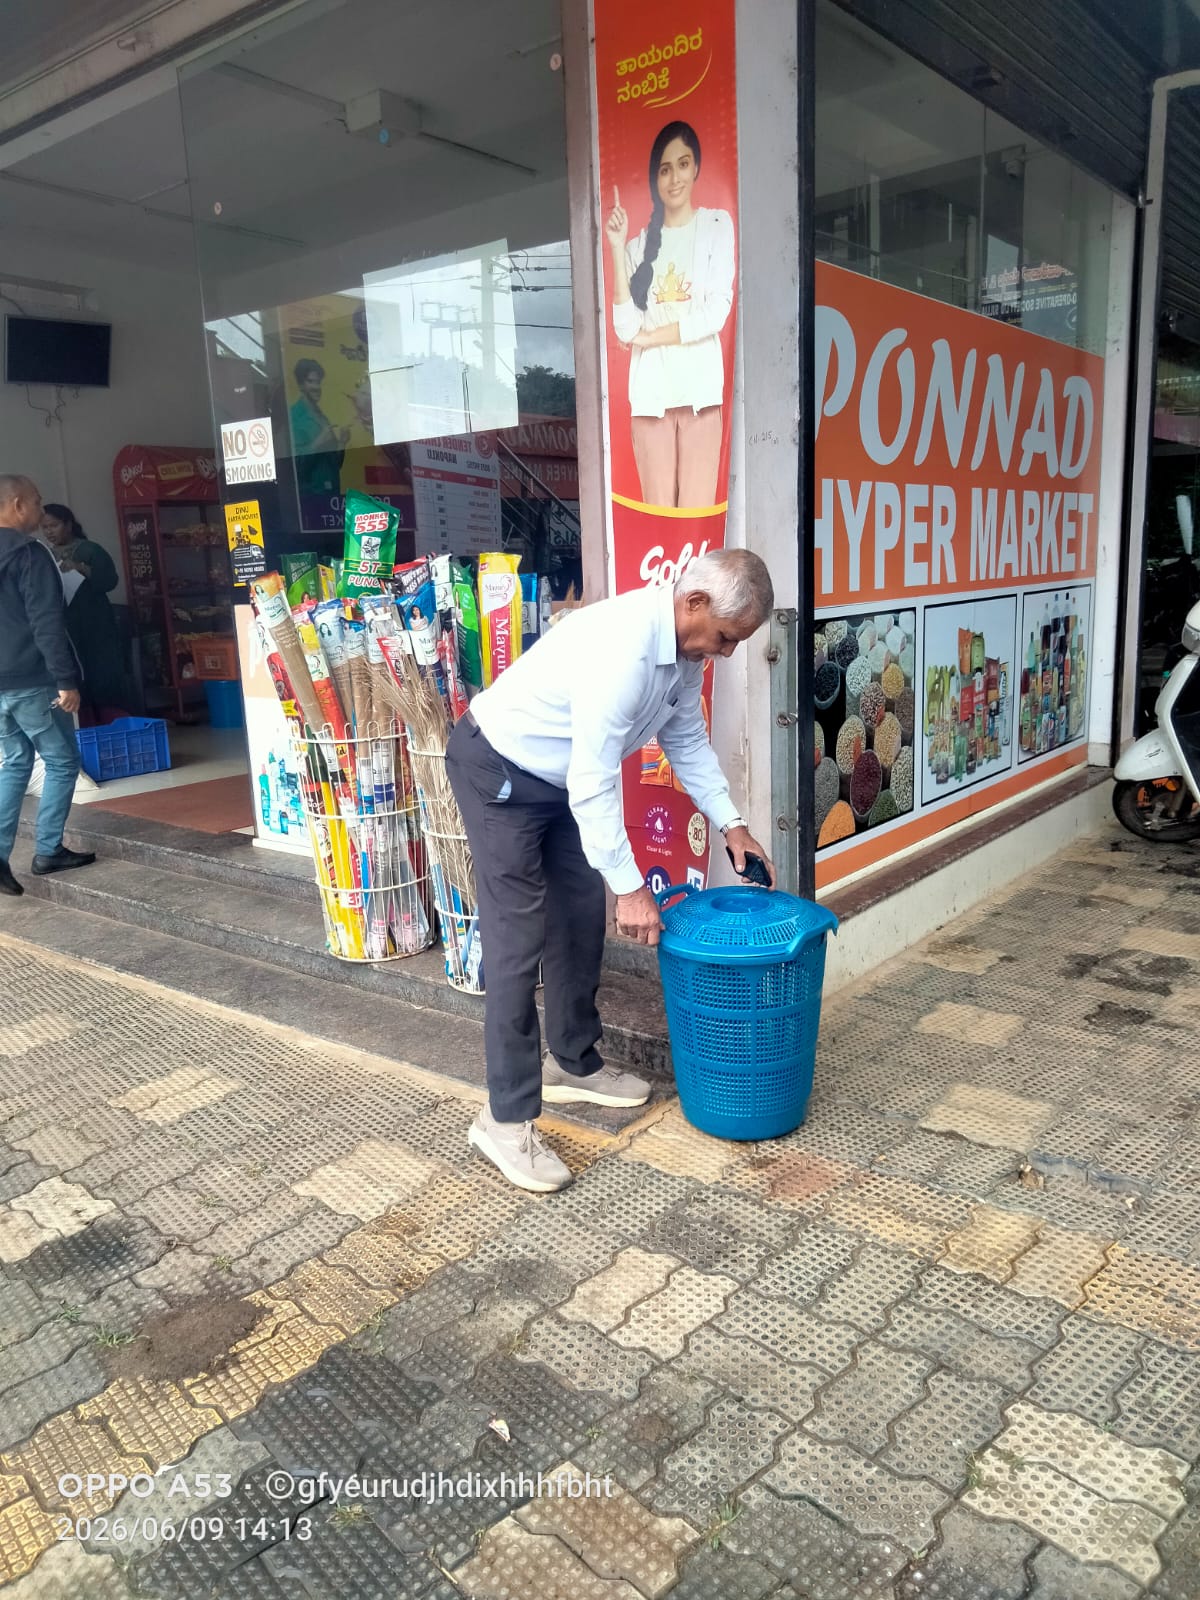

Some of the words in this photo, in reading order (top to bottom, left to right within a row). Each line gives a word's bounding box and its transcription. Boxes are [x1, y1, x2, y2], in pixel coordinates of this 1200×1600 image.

[617, 67, 669, 104] ನಂಬಿಕೆ
[815, 305, 1094, 480] PONNAD
[223, 429, 247, 457] NO
[225, 463, 273, 482] SMOKING
[354, 520, 388, 533] 555
[815, 478, 957, 594] HYPER
[970, 487, 1094, 582] MARKET
[347, 575, 382, 587] PUNC
[492, 617, 509, 670] Mayur
[693, 827, 703, 842] 80
